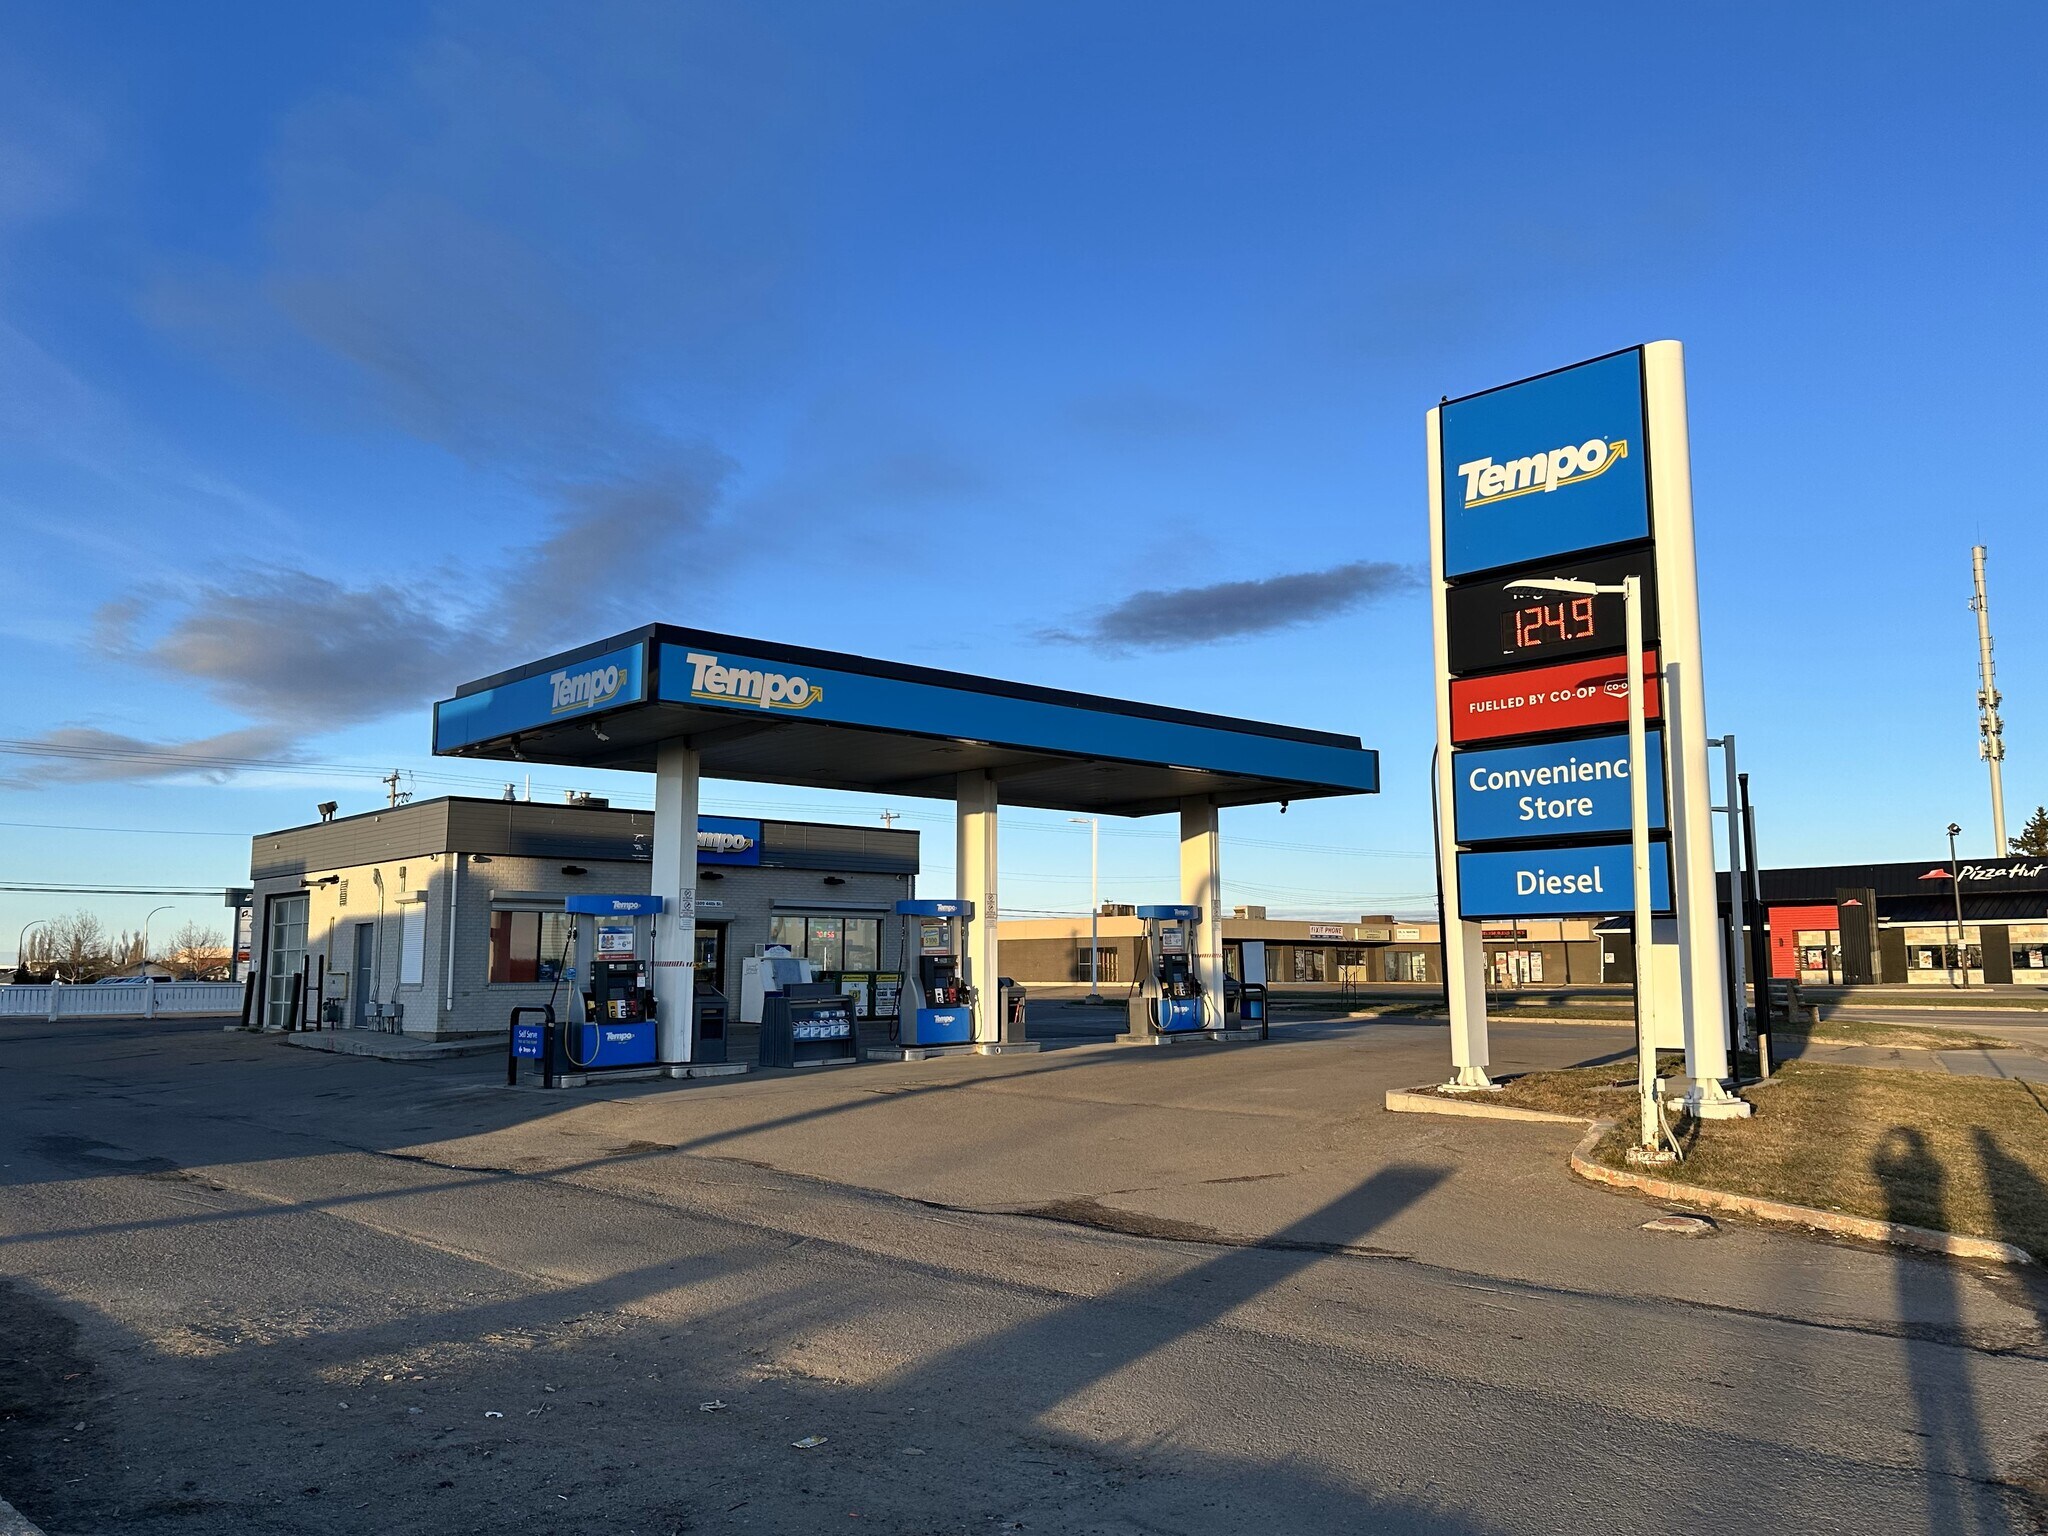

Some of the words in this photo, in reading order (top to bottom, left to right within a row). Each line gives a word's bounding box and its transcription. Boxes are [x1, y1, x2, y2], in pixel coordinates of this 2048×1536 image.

[1458, 437, 1608, 501] Tempo
[1515, 597, 1594, 647] 124.9
[550, 665, 619, 708] Tempo
[686, 652, 810, 709] Tempo
[1607, 682, 1628, 691] CO-O
[1469, 695, 1524, 714] FUELLED
[1529, 692, 1546, 705] BY
[1550, 685, 1597, 702] CO-OP
[1469, 757, 1632, 793] Convenienc
[1519, 796, 1594, 822] Store
[1516, 866, 1604, 896] Diesel
[1957, 865, 2007, 882] Pizza
[2008, 863, 2048, 879] Hut
[612, 900, 639, 910] Tempo
[936, 903, 956, 912] Tempo
[1325, 926, 1342, 934] PHONE
[518, 1029, 527, 1038] Self
[527, 1030, 538, 1039] Serve
[606, 1031, 632, 1041] Tempo
